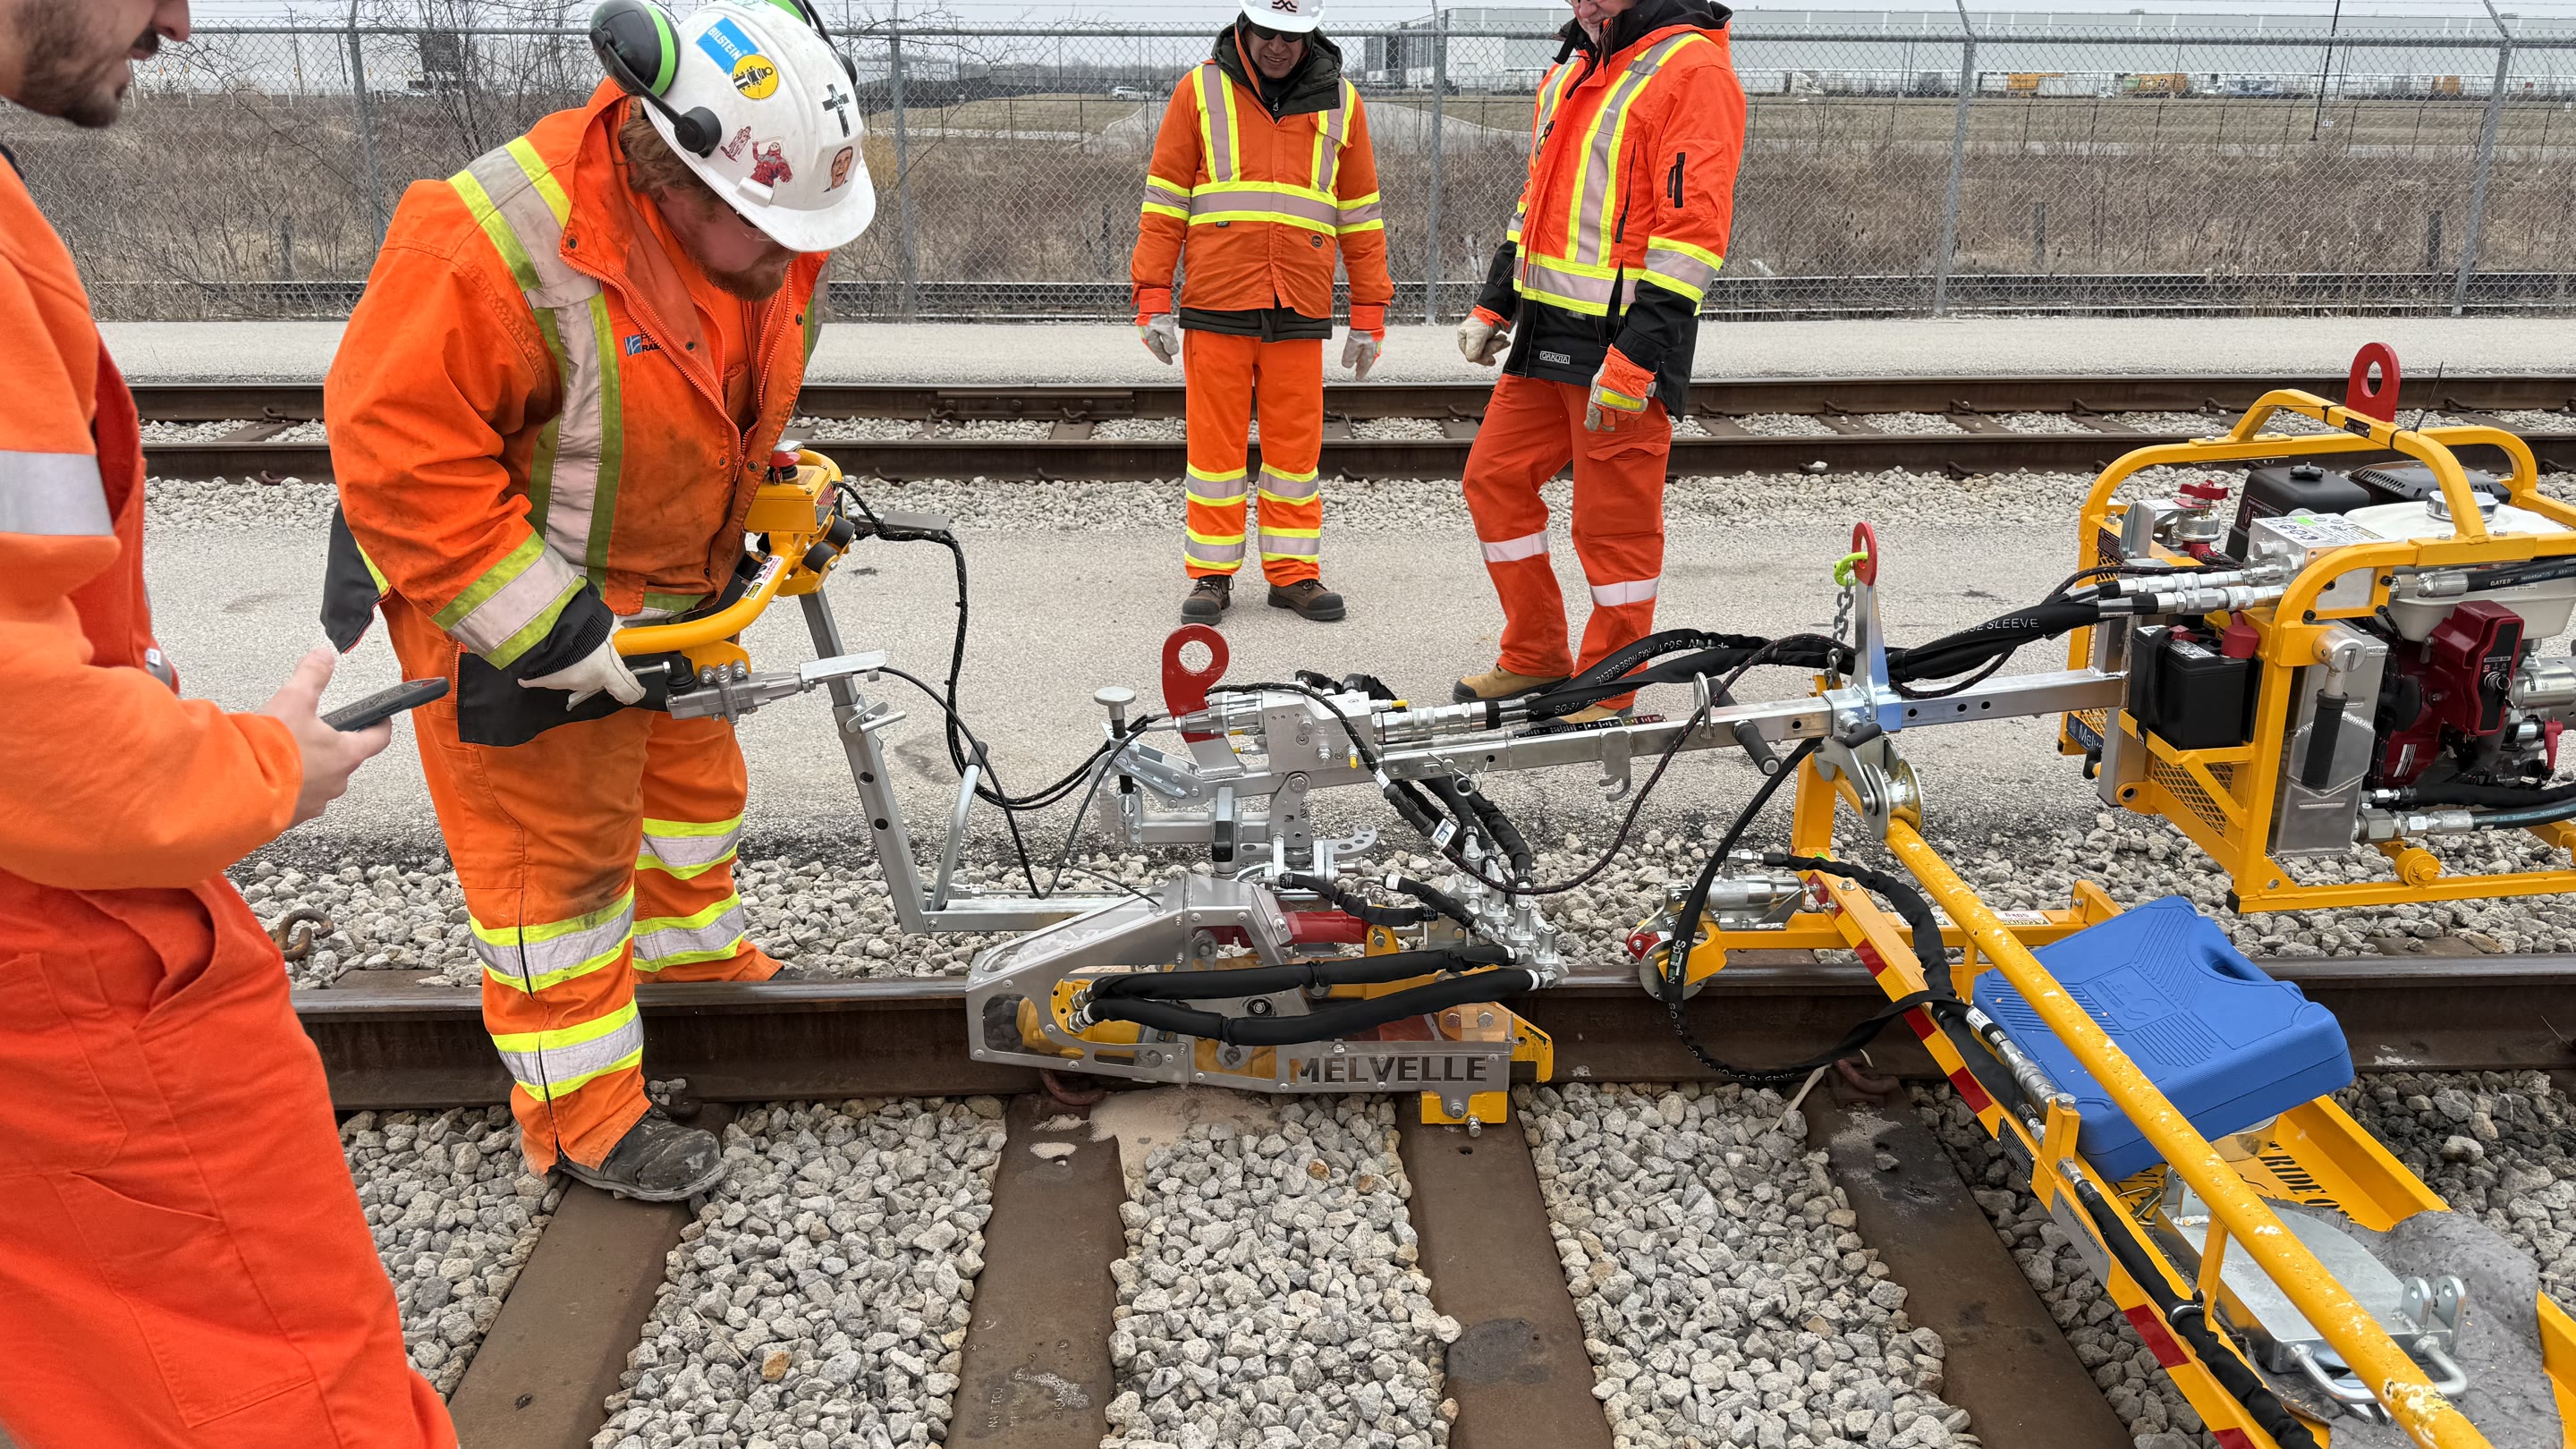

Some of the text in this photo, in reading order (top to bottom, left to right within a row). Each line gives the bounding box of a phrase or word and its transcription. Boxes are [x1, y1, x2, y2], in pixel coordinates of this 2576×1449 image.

[707, 26, 743, 61] BILSTEIN
[1541, 352, 1569, 364] DAKOTA
[2489, 578, 2512, 587] GATES
[1987, 617, 2039, 630] SLEEVE
[1288, 1056, 1487, 1085] MELVELLE
[2258, 1155, 2327, 1196] RIDE
